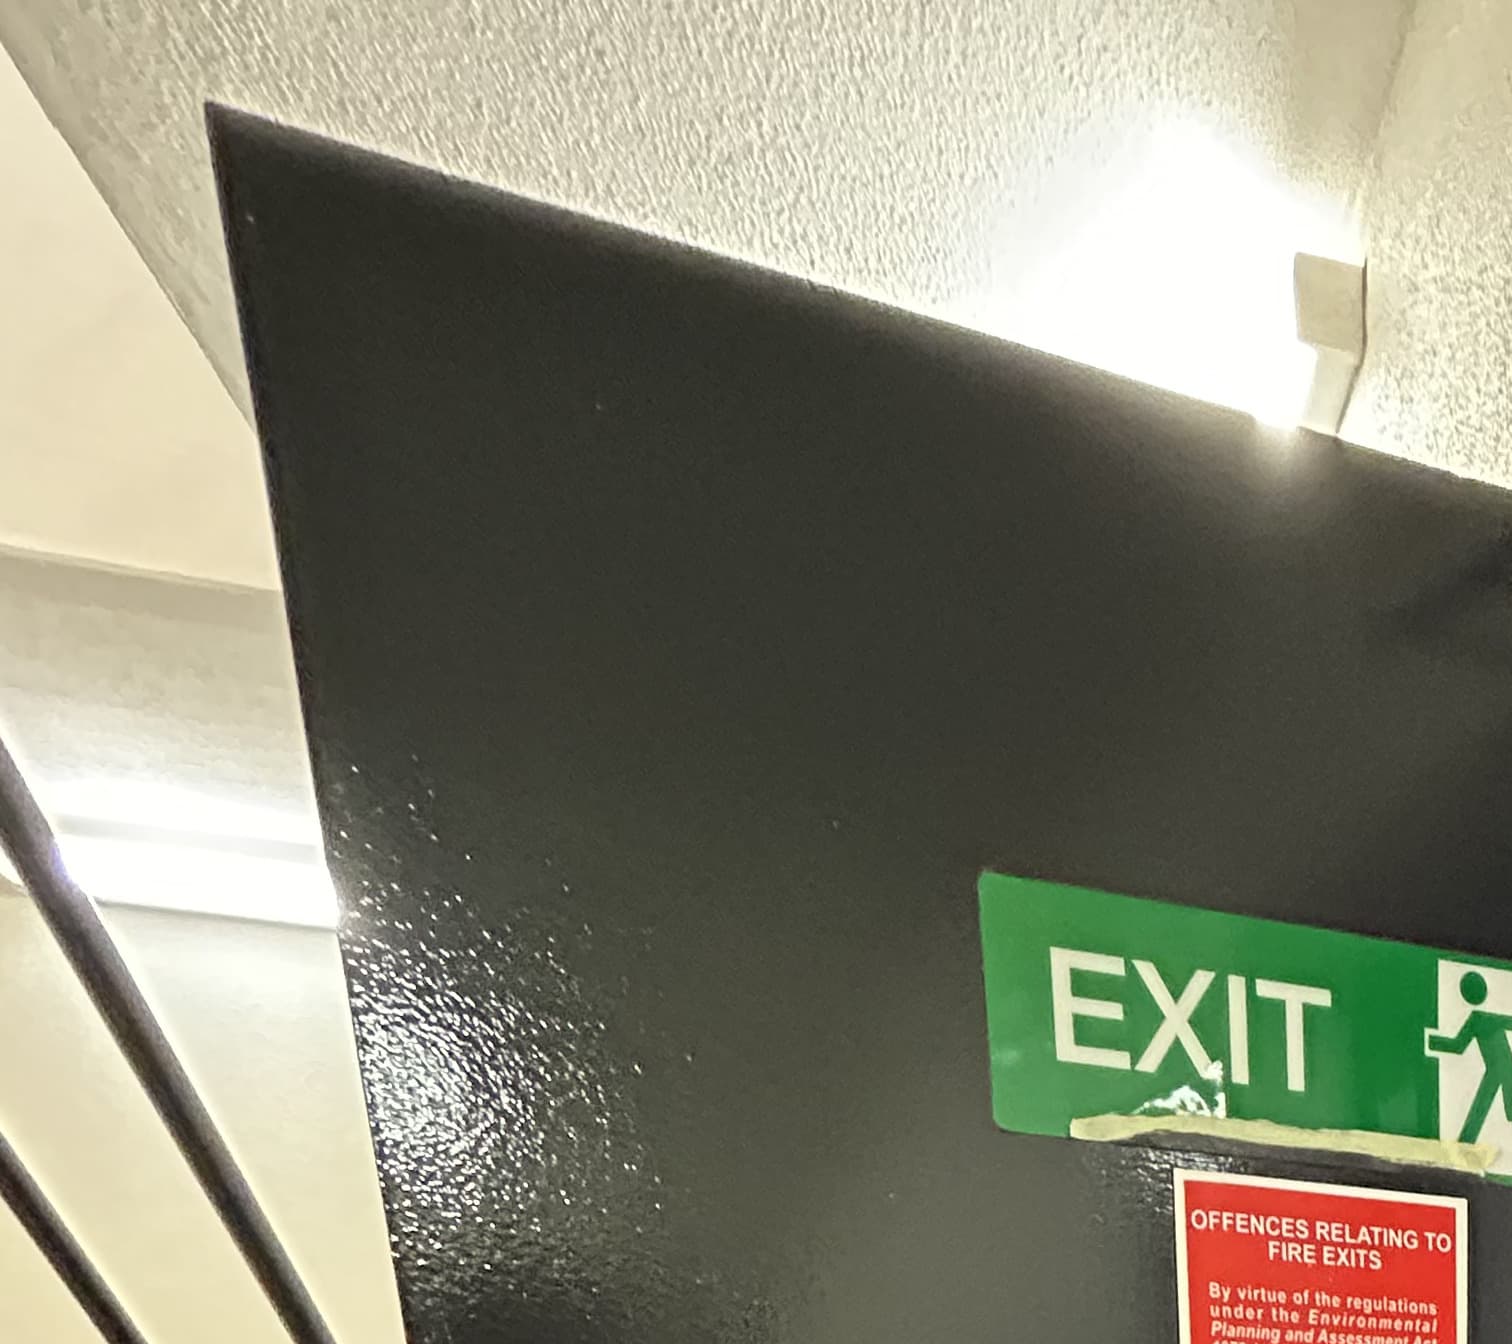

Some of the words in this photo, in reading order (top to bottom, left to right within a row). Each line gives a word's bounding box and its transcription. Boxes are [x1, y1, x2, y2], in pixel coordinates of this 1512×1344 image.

[1050, 946, 1332, 1092] EXIT
[1191, 1210, 1308, 1239] OFFENCES
[1316, 1222, 1418, 1248] RELATING
[1426, 1232, 1452, 1253] TO
[1269, 1241, 1316, 1264] FIRE
[1323, 1247, 1382, 1269] EXITS
[1208, 1282, 1231, 1302] By
[1238, 1285, 1286, 1304] virtue
[1293, 1291, 1310, 1305] of
[1316, 1291, 1340, 1307] the
[1346, 1295, 1437, 1315] regulations
[1210, 1304, 1264, 1320] under
[1272, 1307, 1300, 1322] the
[1309, 1311, 1437, 1333] Environmental
[1211, 1322, 1280, 1344] Planning
[1285, 1328, 1313, 1343] and
